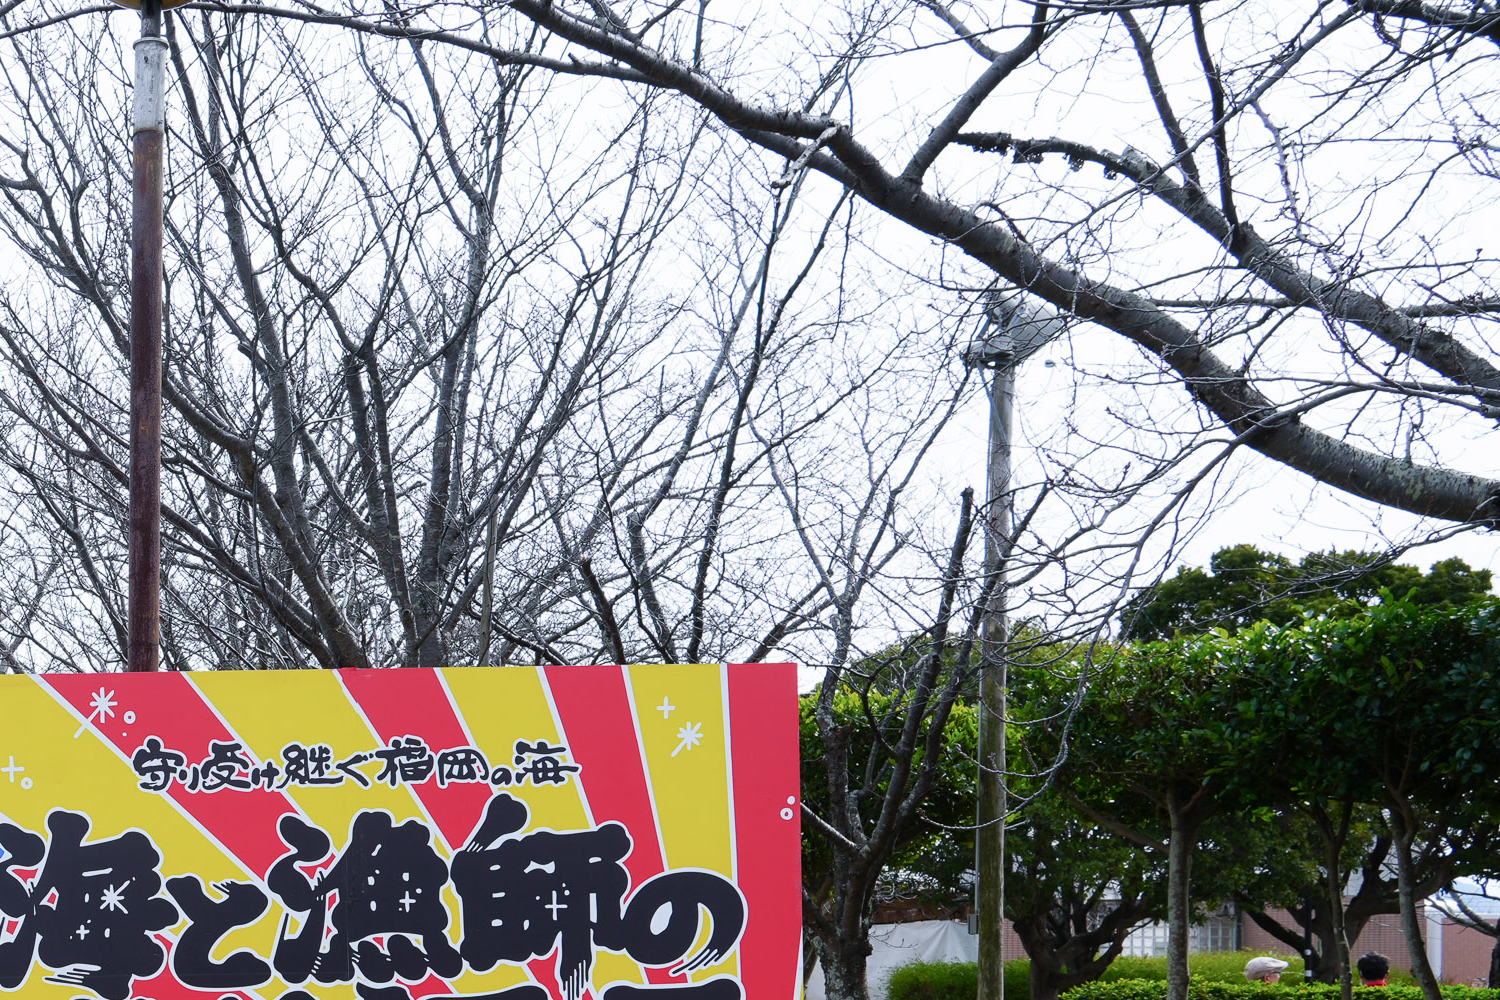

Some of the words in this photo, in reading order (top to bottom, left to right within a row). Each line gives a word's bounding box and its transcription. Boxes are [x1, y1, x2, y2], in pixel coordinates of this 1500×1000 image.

[132, 737, 579, 790] 守り受け継ぐ福岡の海
